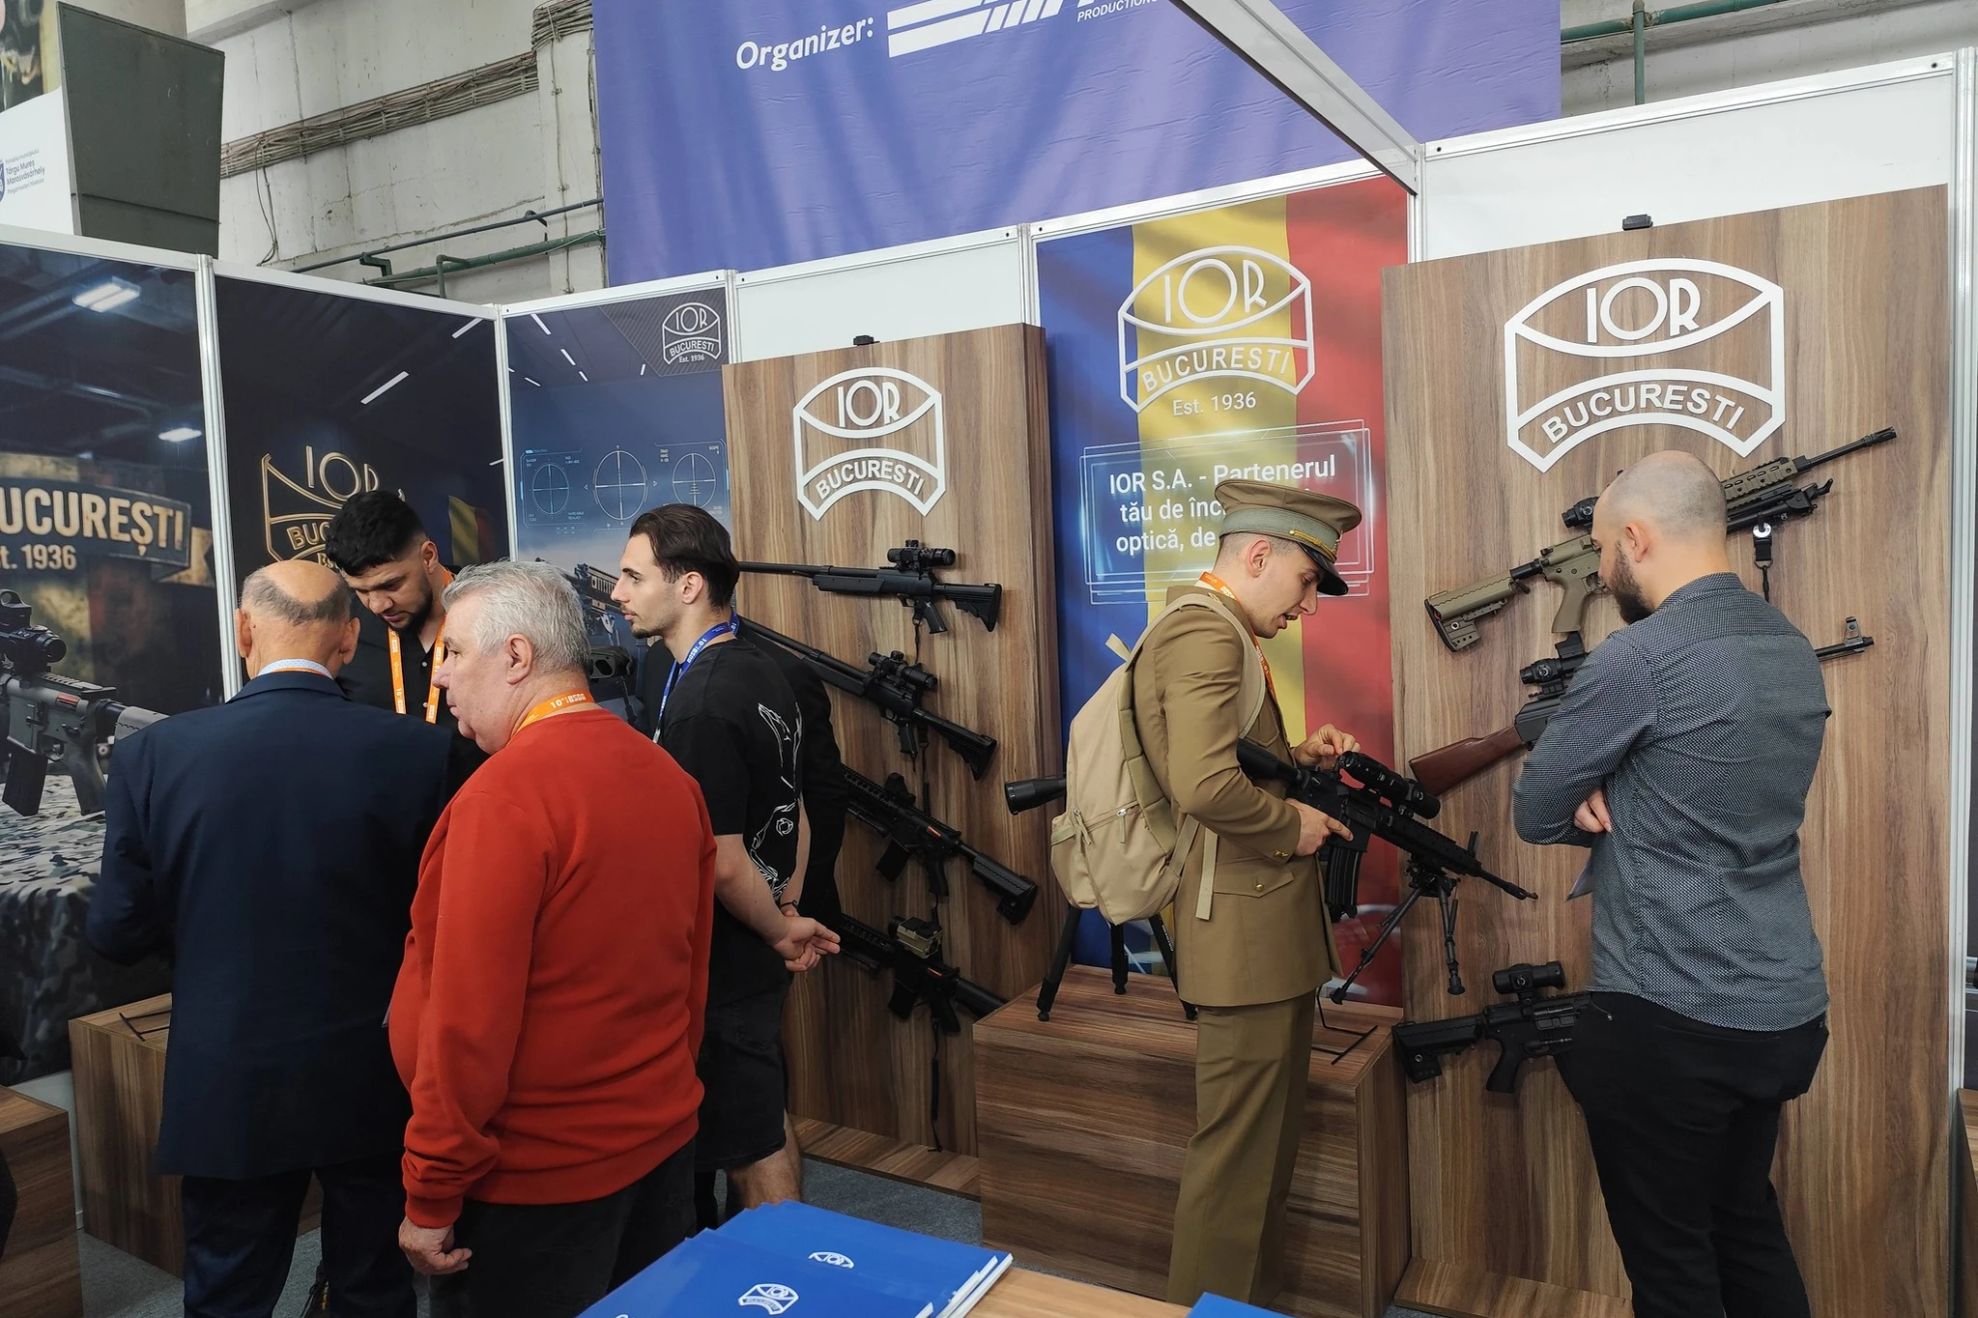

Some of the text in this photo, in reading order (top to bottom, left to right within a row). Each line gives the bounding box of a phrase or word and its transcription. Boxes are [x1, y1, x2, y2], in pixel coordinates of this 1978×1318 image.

[736, 17, 873, 71] Organizer:
[1164, 258, 1267, 324] IOR
[1587, 277, 1701, 343] IOR
[675, 307, 708, 332] IOR
[669, 340, 715, 357] BUCURESTI
[1142, 347, 1289, 392] BUCURESTI
[837, 379, 901, 428] IOR
[1173, 392, 1257, 416] Est. 1936
[1541, 384, 1745, 444] BUCURESTI
[815, 460, 925, 500] BUCURESTI
[1110, 472, 1146, 495] IOR
[1152, 468, 1192, 490] S.A.
[1214, 454, 1336, 486] Partenerul
[1120, 496, 1226, 522] tău de înc
[286, 521, 330, 550] BUC
[1116, 526, 1216, 556] optică, de
[21, 544, 77, 570] 1936
